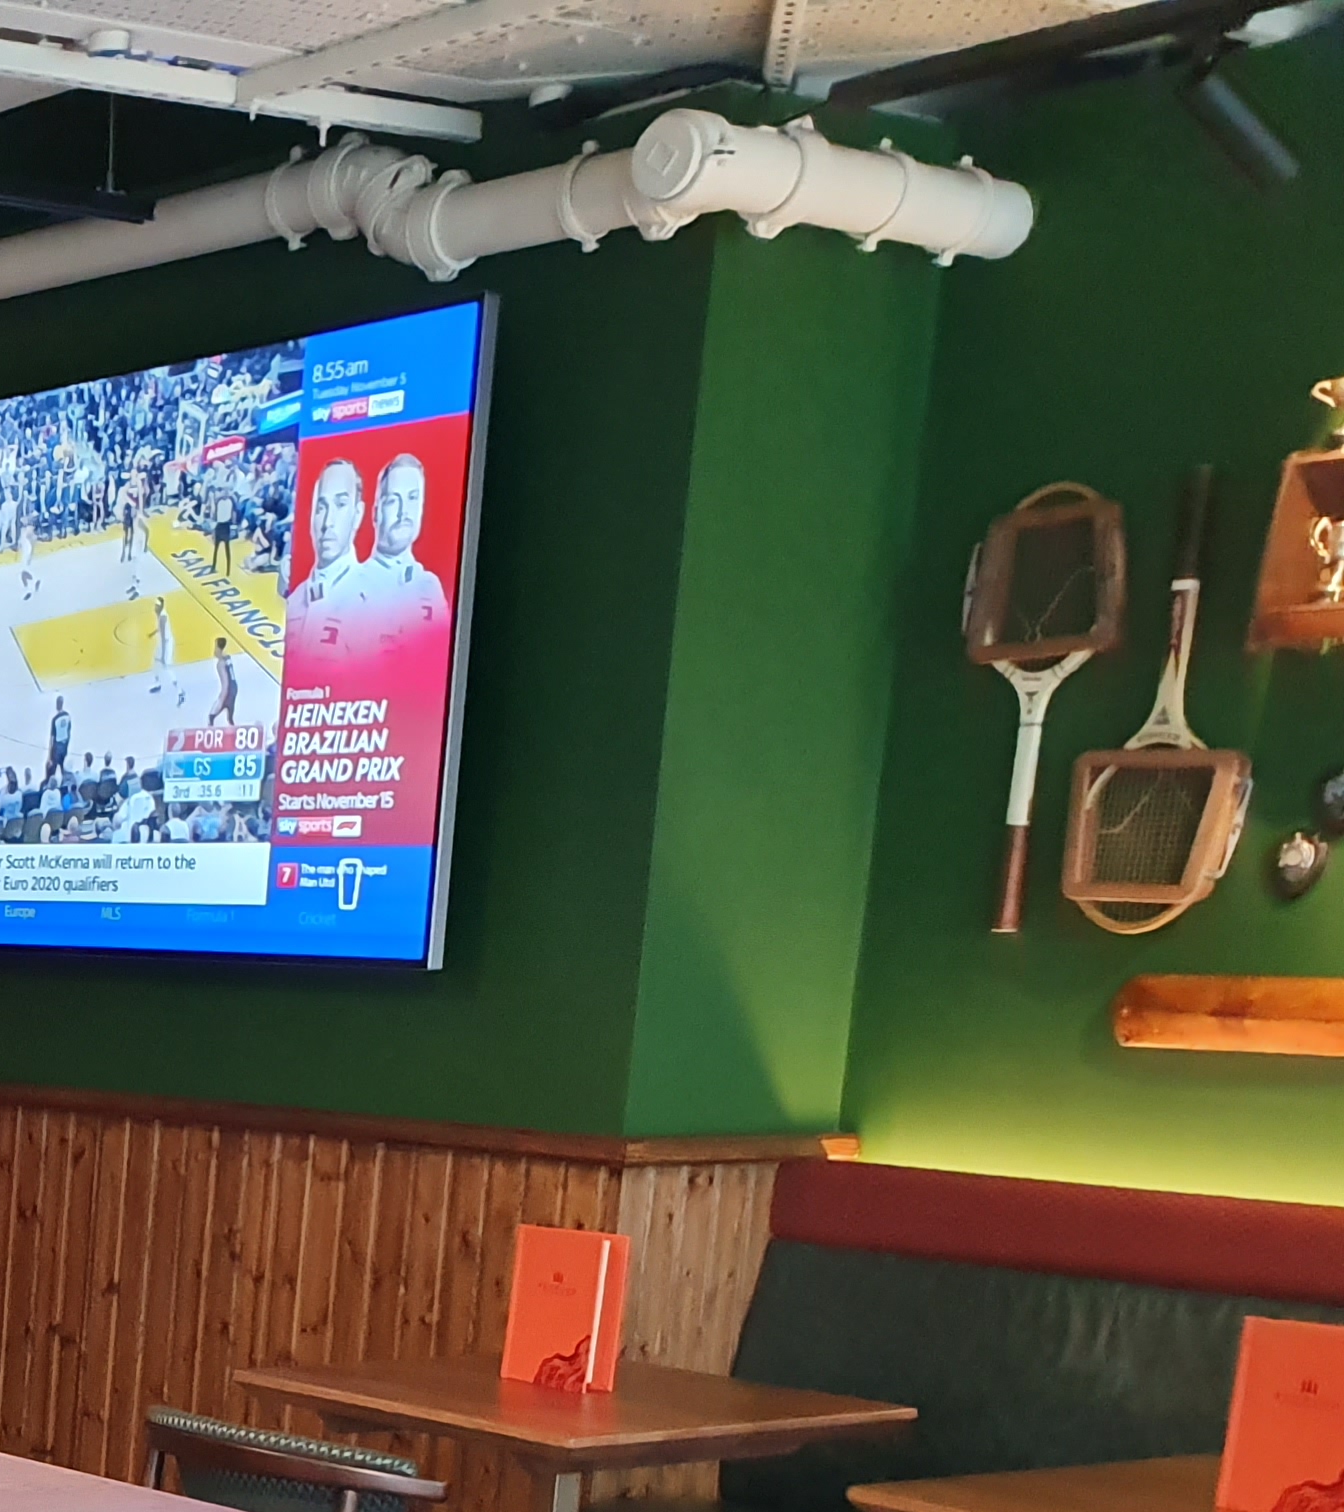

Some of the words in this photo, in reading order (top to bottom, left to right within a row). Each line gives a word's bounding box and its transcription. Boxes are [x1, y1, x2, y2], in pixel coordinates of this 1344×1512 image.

[312, 384, 349, 399] Tuesday
[350, 376, 399, 393] November
[399, 372, 407, 385] 5
[332, 400, 368, 420] sports
[371, 396, 400, 410] news
[171, 549, 218, 578] SAN
[284, 698, 388, 728] HEINEKEN
[194, 729, 224, 749] POR
[235, 727, 259, 749] 80
[282, 727, 389, 756] BRAZILIAN
[193, 757, 212, 776] GS
[233, 755, 257, 777] 85
[280, 757, 354, 784] GRAND
[354, 755, 405, 782] PRIX
[172, 785, 190, 798] 3rd
[278, 792, 315, 811] Starts
[316, 791, 380, 810] November
[379, 791, 394, 809] 15
[278, 820, 297, 835] sky
[298, 820, 332, 835] sports
[5, 854, 36, 870] Scott
[38, 853, 90, 870] McKenna
[92, 853, 113, 870] will
[115, 854, 154, 871] return
[157, 855, 172, 870] to
[174, 853, 197, 870] the
[3, 876, 29, 891] Euro
[30, 876, 61, 892] 2020
[62, 876, 119, 895] qualifiers
[281, 867, 292, 884] 7
[4, 904, 37, 919] Europe
